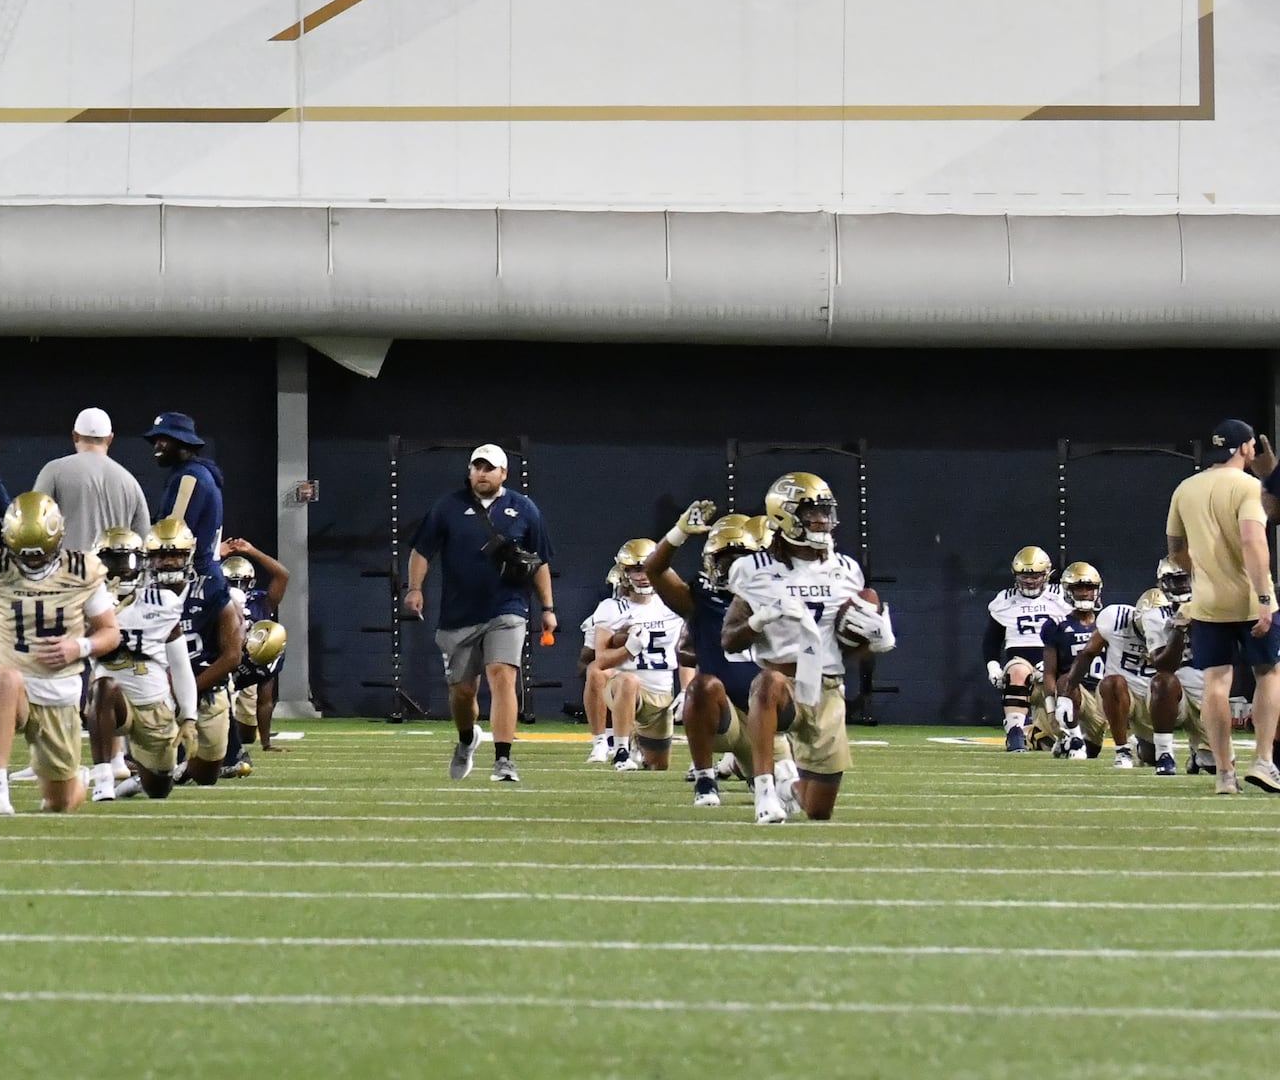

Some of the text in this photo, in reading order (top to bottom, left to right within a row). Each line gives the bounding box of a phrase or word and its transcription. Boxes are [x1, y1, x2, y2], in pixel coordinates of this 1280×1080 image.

[774, 478, 806, 500] GT
[786, 585, 832, 597] TECH
[1020, 604, 1047, 614] TECH
[11, 600, 67, 653] 14
